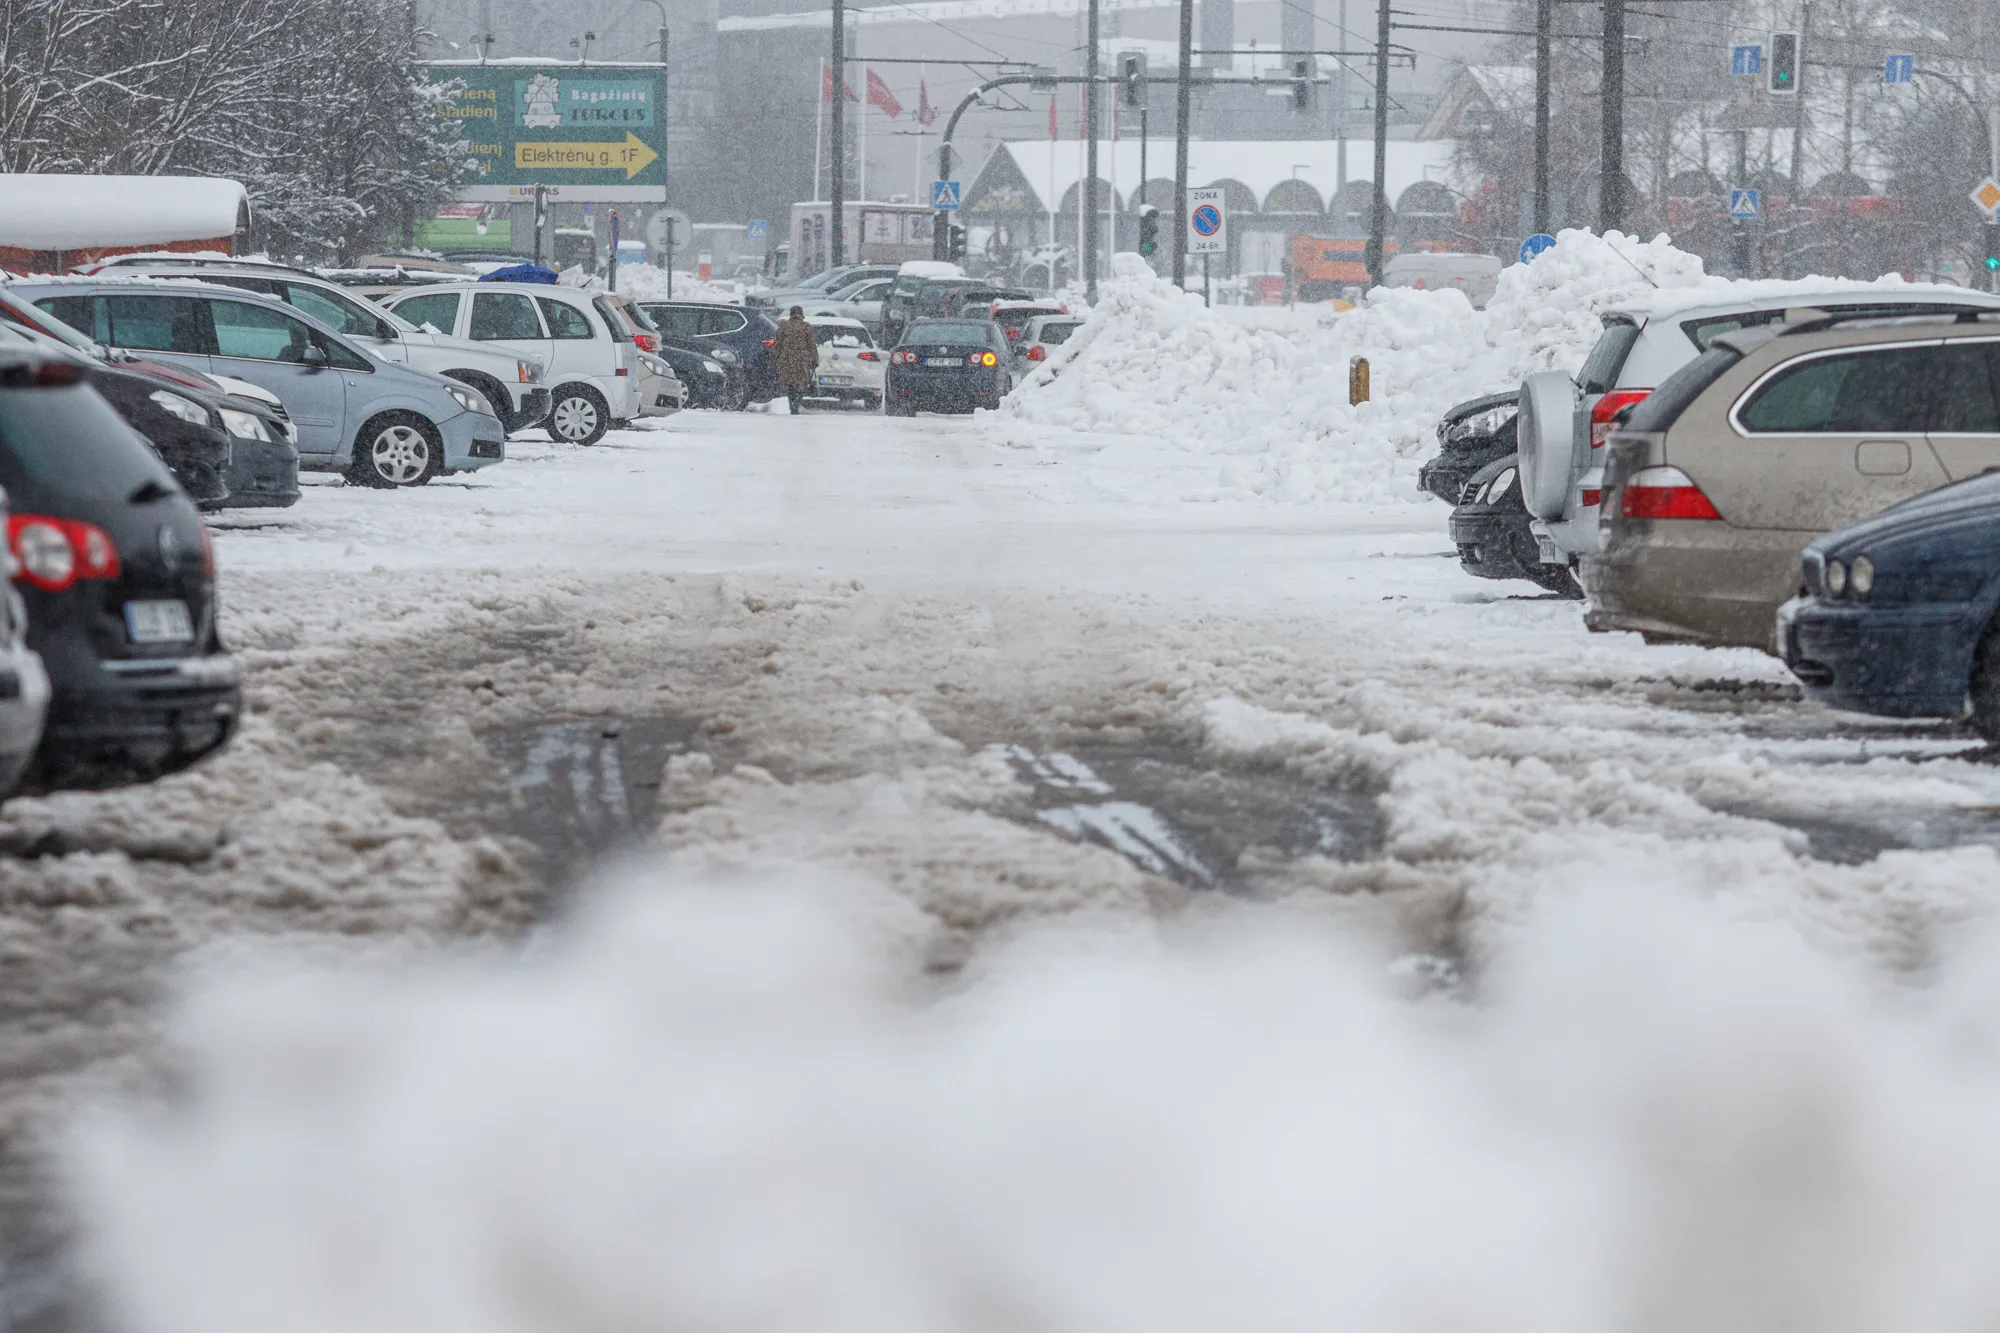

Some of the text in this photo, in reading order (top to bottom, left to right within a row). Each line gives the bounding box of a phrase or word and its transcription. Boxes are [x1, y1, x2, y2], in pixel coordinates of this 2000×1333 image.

[521, 148, 639, 166] Elektrėnų g. 1F
[519, 187, 559, 196] URAS
[1193, 191, 1219, 200] ZONA
